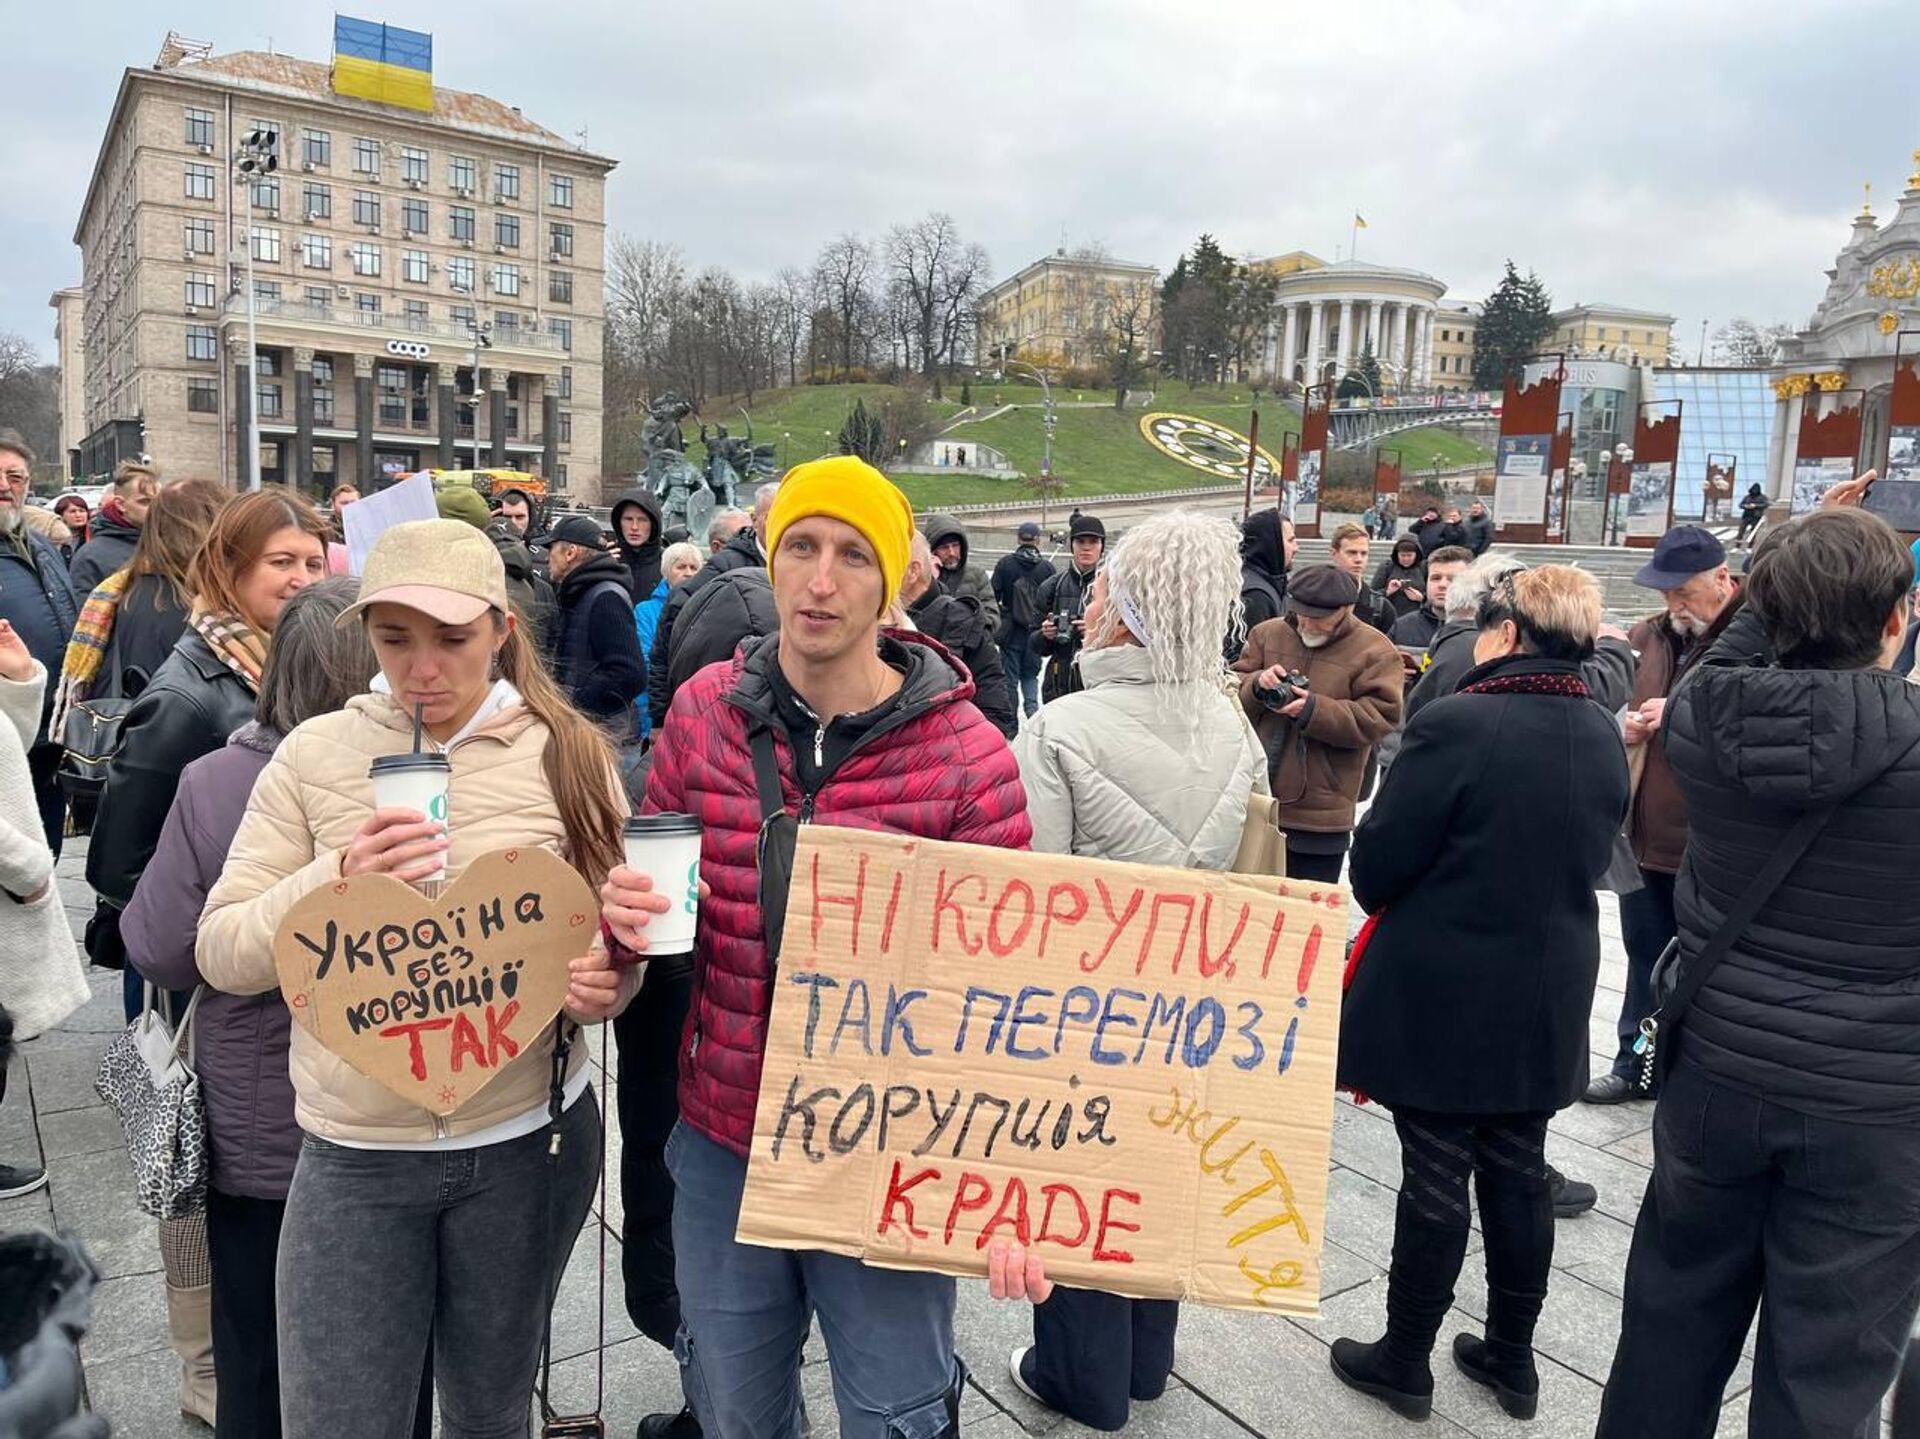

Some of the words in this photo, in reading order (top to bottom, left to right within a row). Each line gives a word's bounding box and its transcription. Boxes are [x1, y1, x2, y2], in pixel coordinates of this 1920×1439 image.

[387, 340, 430, 359] coop
[294, 892, 544, 980] Україна
[810, 842, 916, 957] НІ
[931, 868, 1342, 994] КОРУПЦІЇ
[378, 1000, 520, 1081] ТАК
[788, 972, 932, 1059] ТАК
[954, 984, 1308, 1076] ПЕРЕМОЗІ
